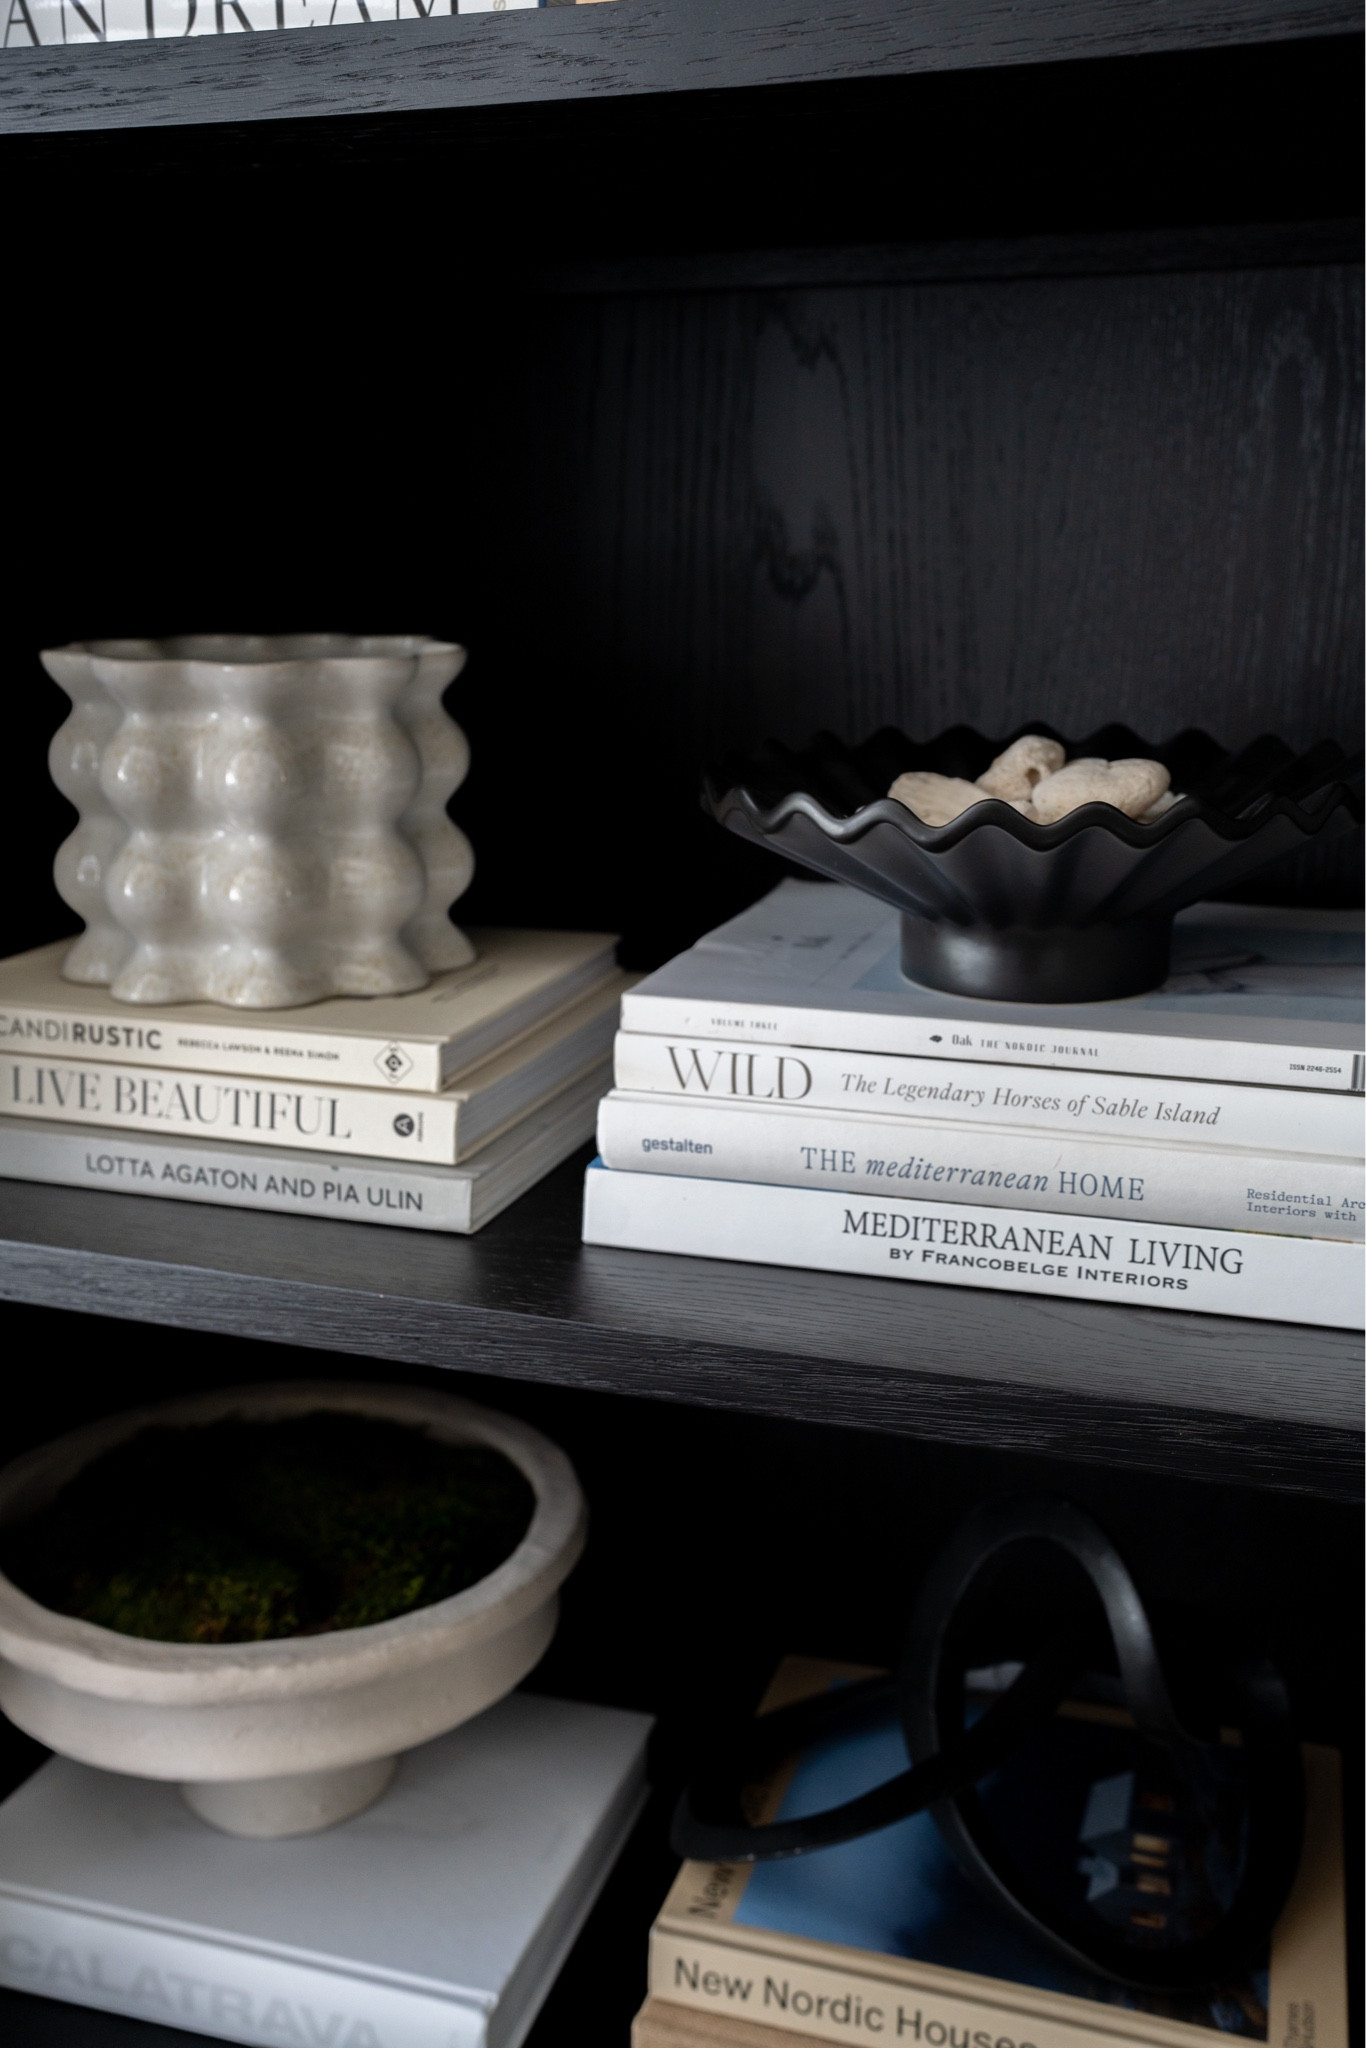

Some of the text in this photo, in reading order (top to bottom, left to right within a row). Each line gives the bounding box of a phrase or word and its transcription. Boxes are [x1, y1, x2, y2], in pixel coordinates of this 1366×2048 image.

[951, 1034, 1099, 1058] Oak THE NORDIC JOURNAL
[665, 1045, 1222, 1126] WILD The Legendary Horses of Sable Island
[1289, 1063, 1305, 1071] ISSN
[12, 1064, 101, 1112] LIVE
[113, 1077, 353, 1140] BEAUTIFUL
[641, 1136, 714, 1155] gestalten
[85, 1153, 424, 1211] LOTTA AGATON AND PIA ULIN
[799, 1146, 1146, 1202] THE mediterranean HOME
[1246, 1187, 1365, 1210] Residential Arc
[1246, 1202, 1357, 1222] Interiors with
[842, 1208, 1244, 1276] MEDITERRANEAN LIVING
[888, 1247, 915, 1261] BY
[673, 1957, 753, 2002] New
[763, 1974, 886, 2034] Nordic
